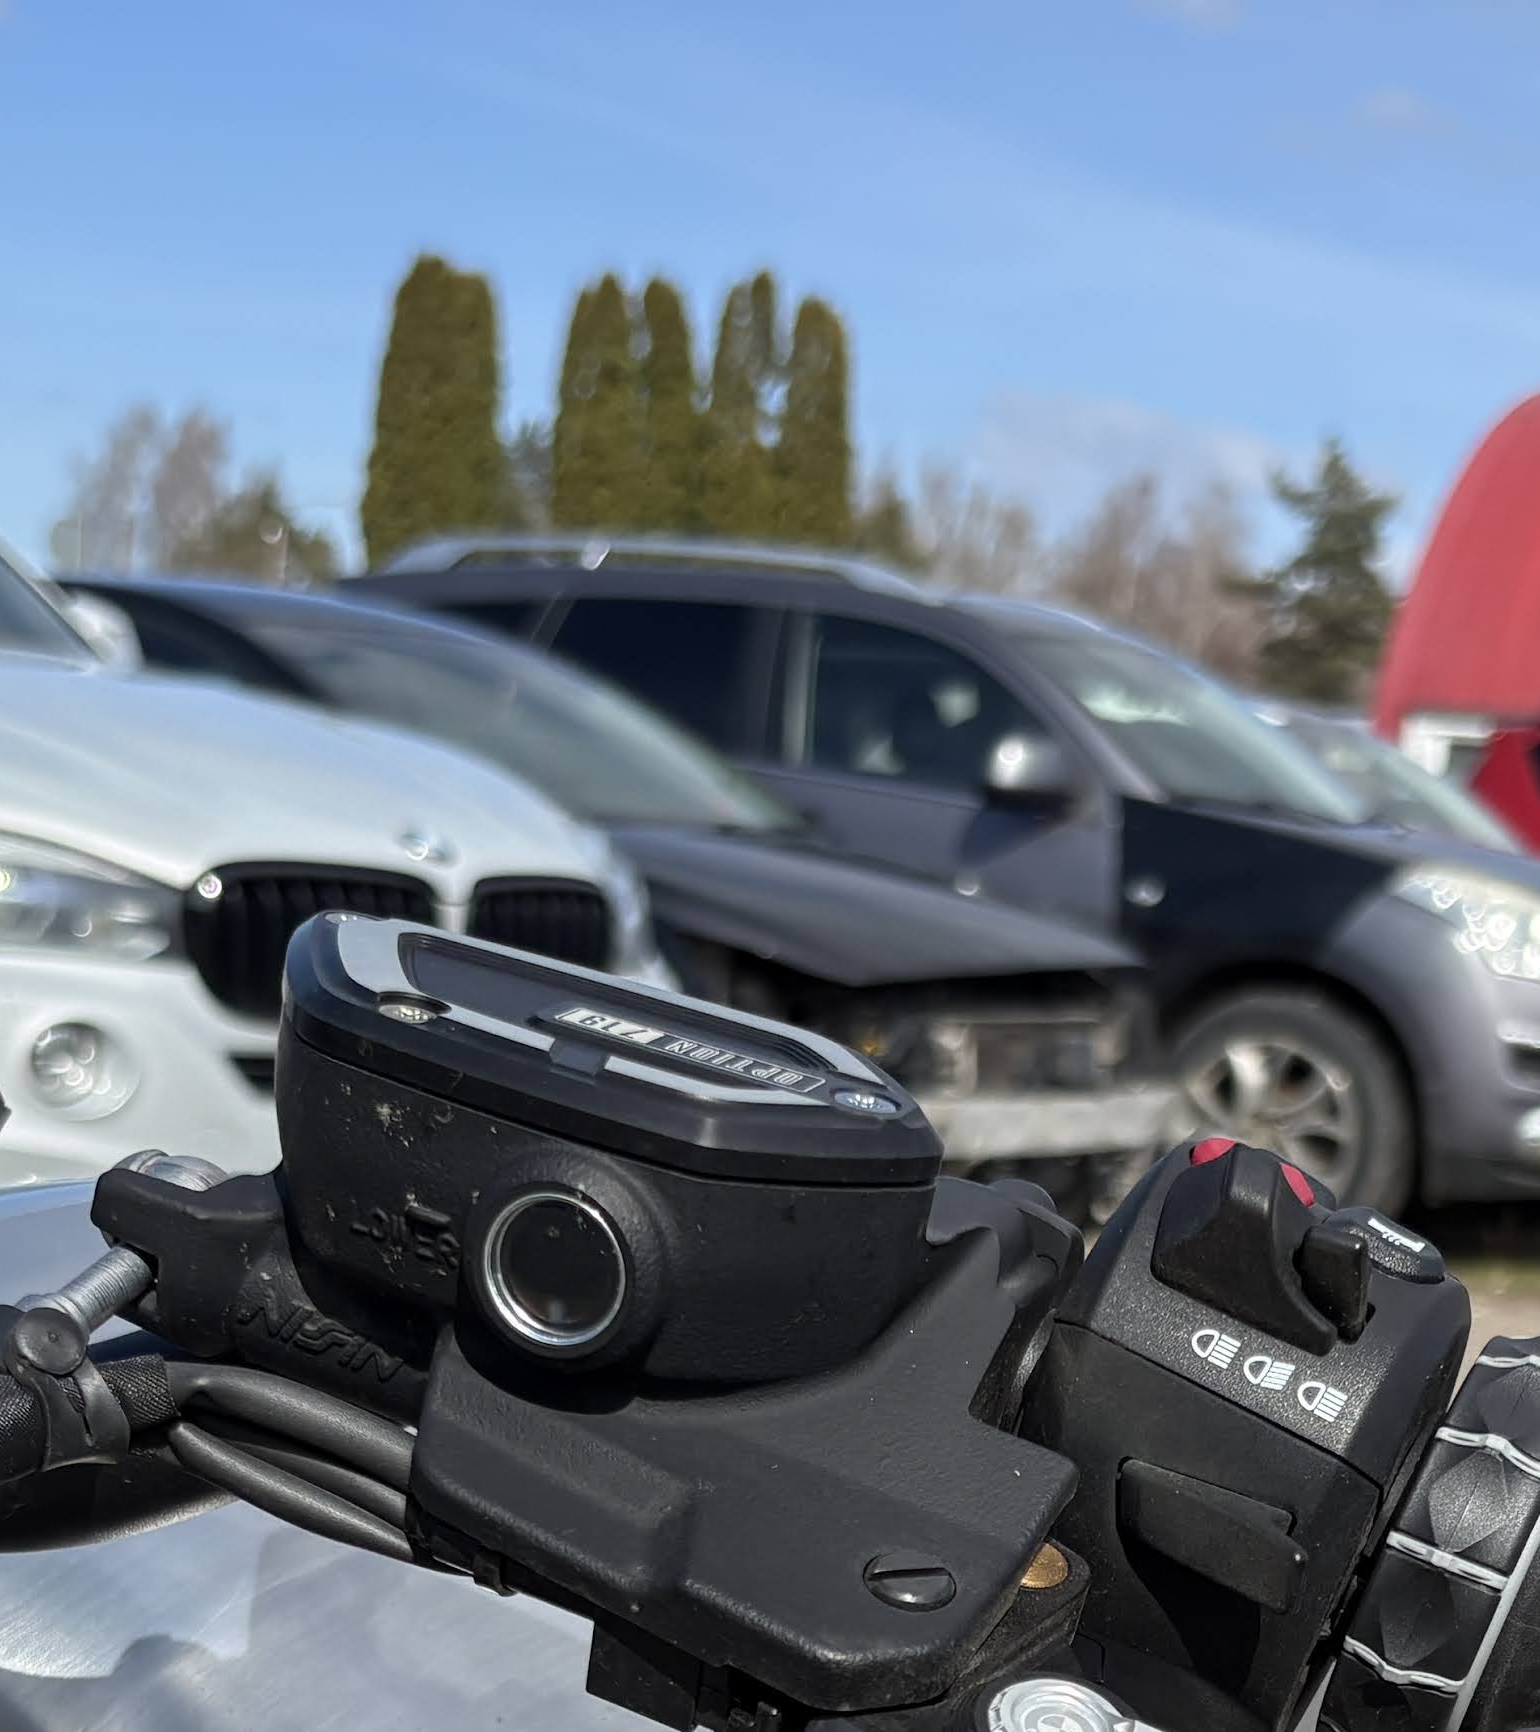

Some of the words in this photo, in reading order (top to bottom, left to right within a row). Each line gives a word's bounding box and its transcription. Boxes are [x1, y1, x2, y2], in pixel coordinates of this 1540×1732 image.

[579, 1013, 645, 1040] 719
[667, 1038, 801, 1086] OPTION
[238, 1304, 404, 1380] NISSIN
